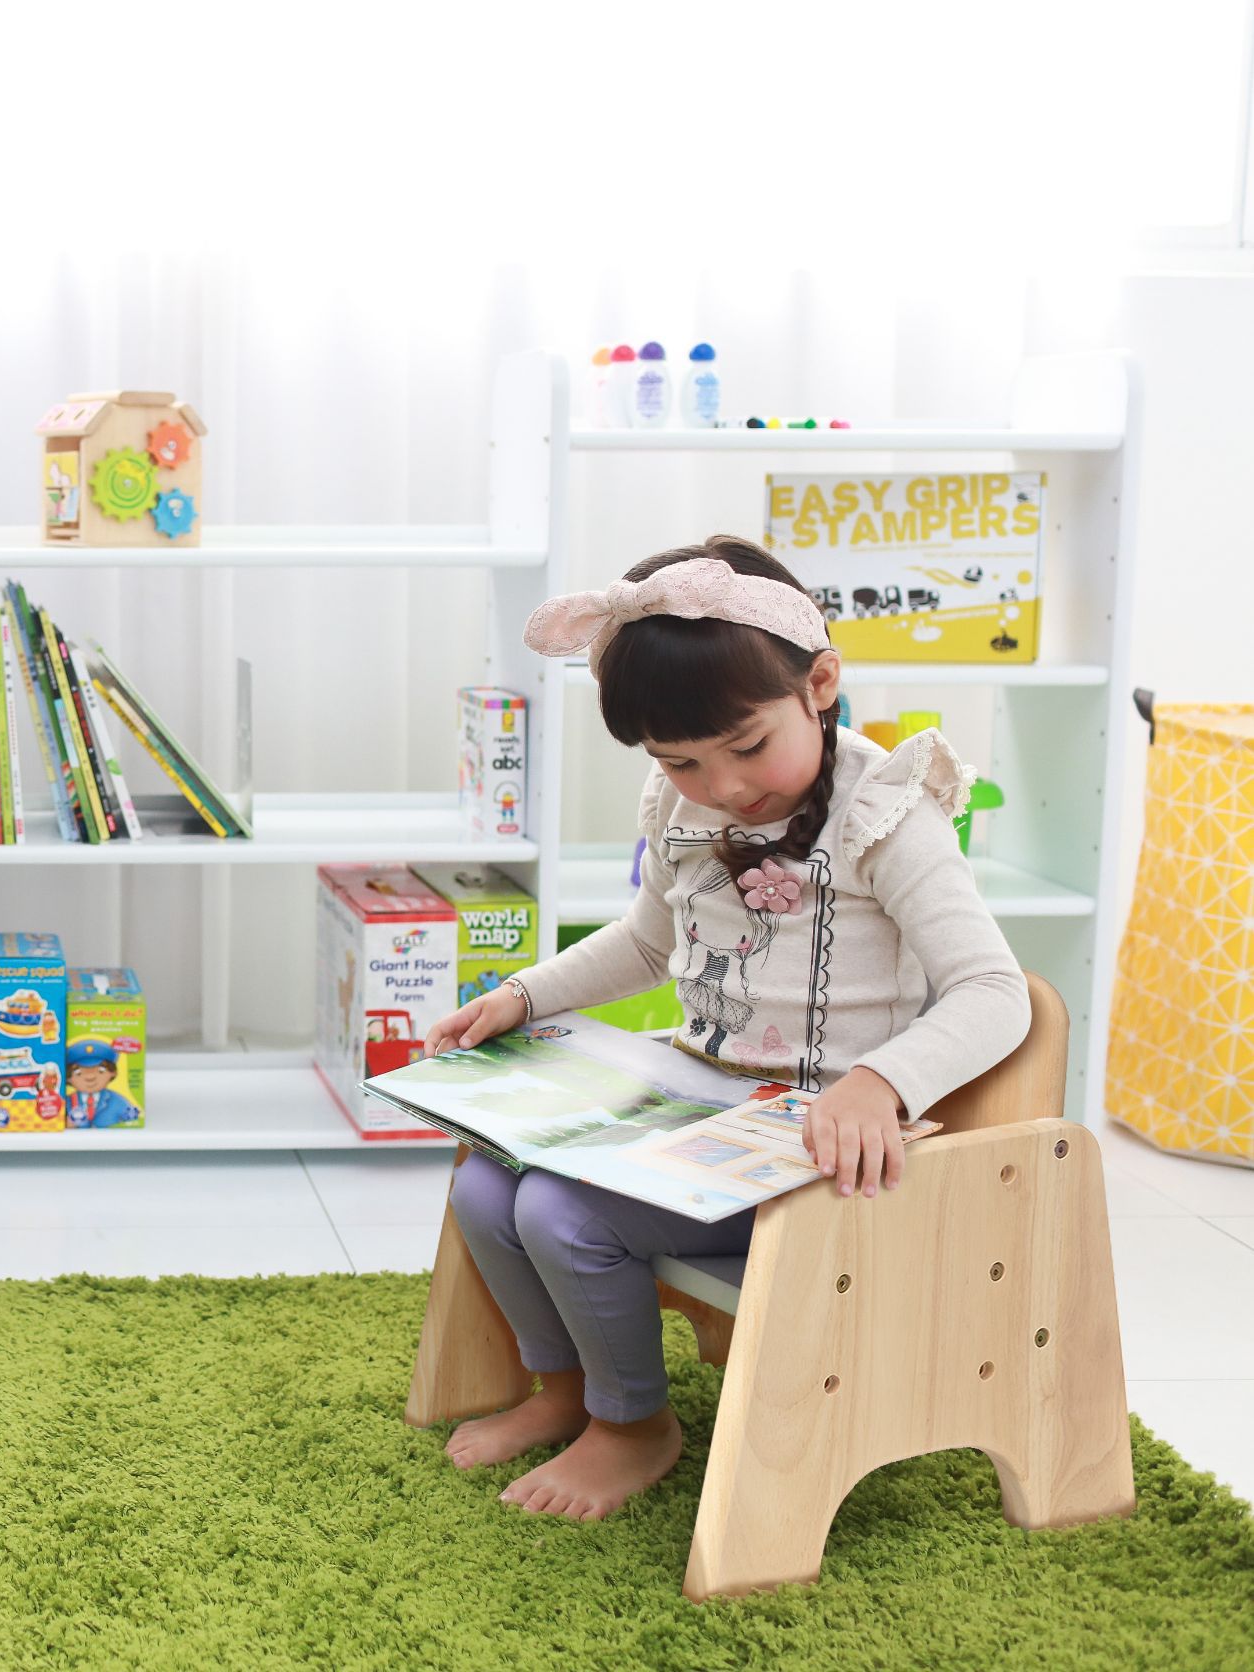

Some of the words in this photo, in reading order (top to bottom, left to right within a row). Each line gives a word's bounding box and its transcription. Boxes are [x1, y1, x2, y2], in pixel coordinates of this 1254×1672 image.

[771, 480, 893, 518] EASY
[906, 474, 1010, 511] GRIP
[792, 502, 1040, 549] STAMPERS
[492, 754, 522, 770] abc
[461, 908, 529, 928] world
[469, 928, 521, 949] map
[370, 959, 409, 972] Giant
[415, 959, 450, 971] Floor
[385, 976, 434, 987] Puzzle
[394, 992, 425, 1002] Farm
